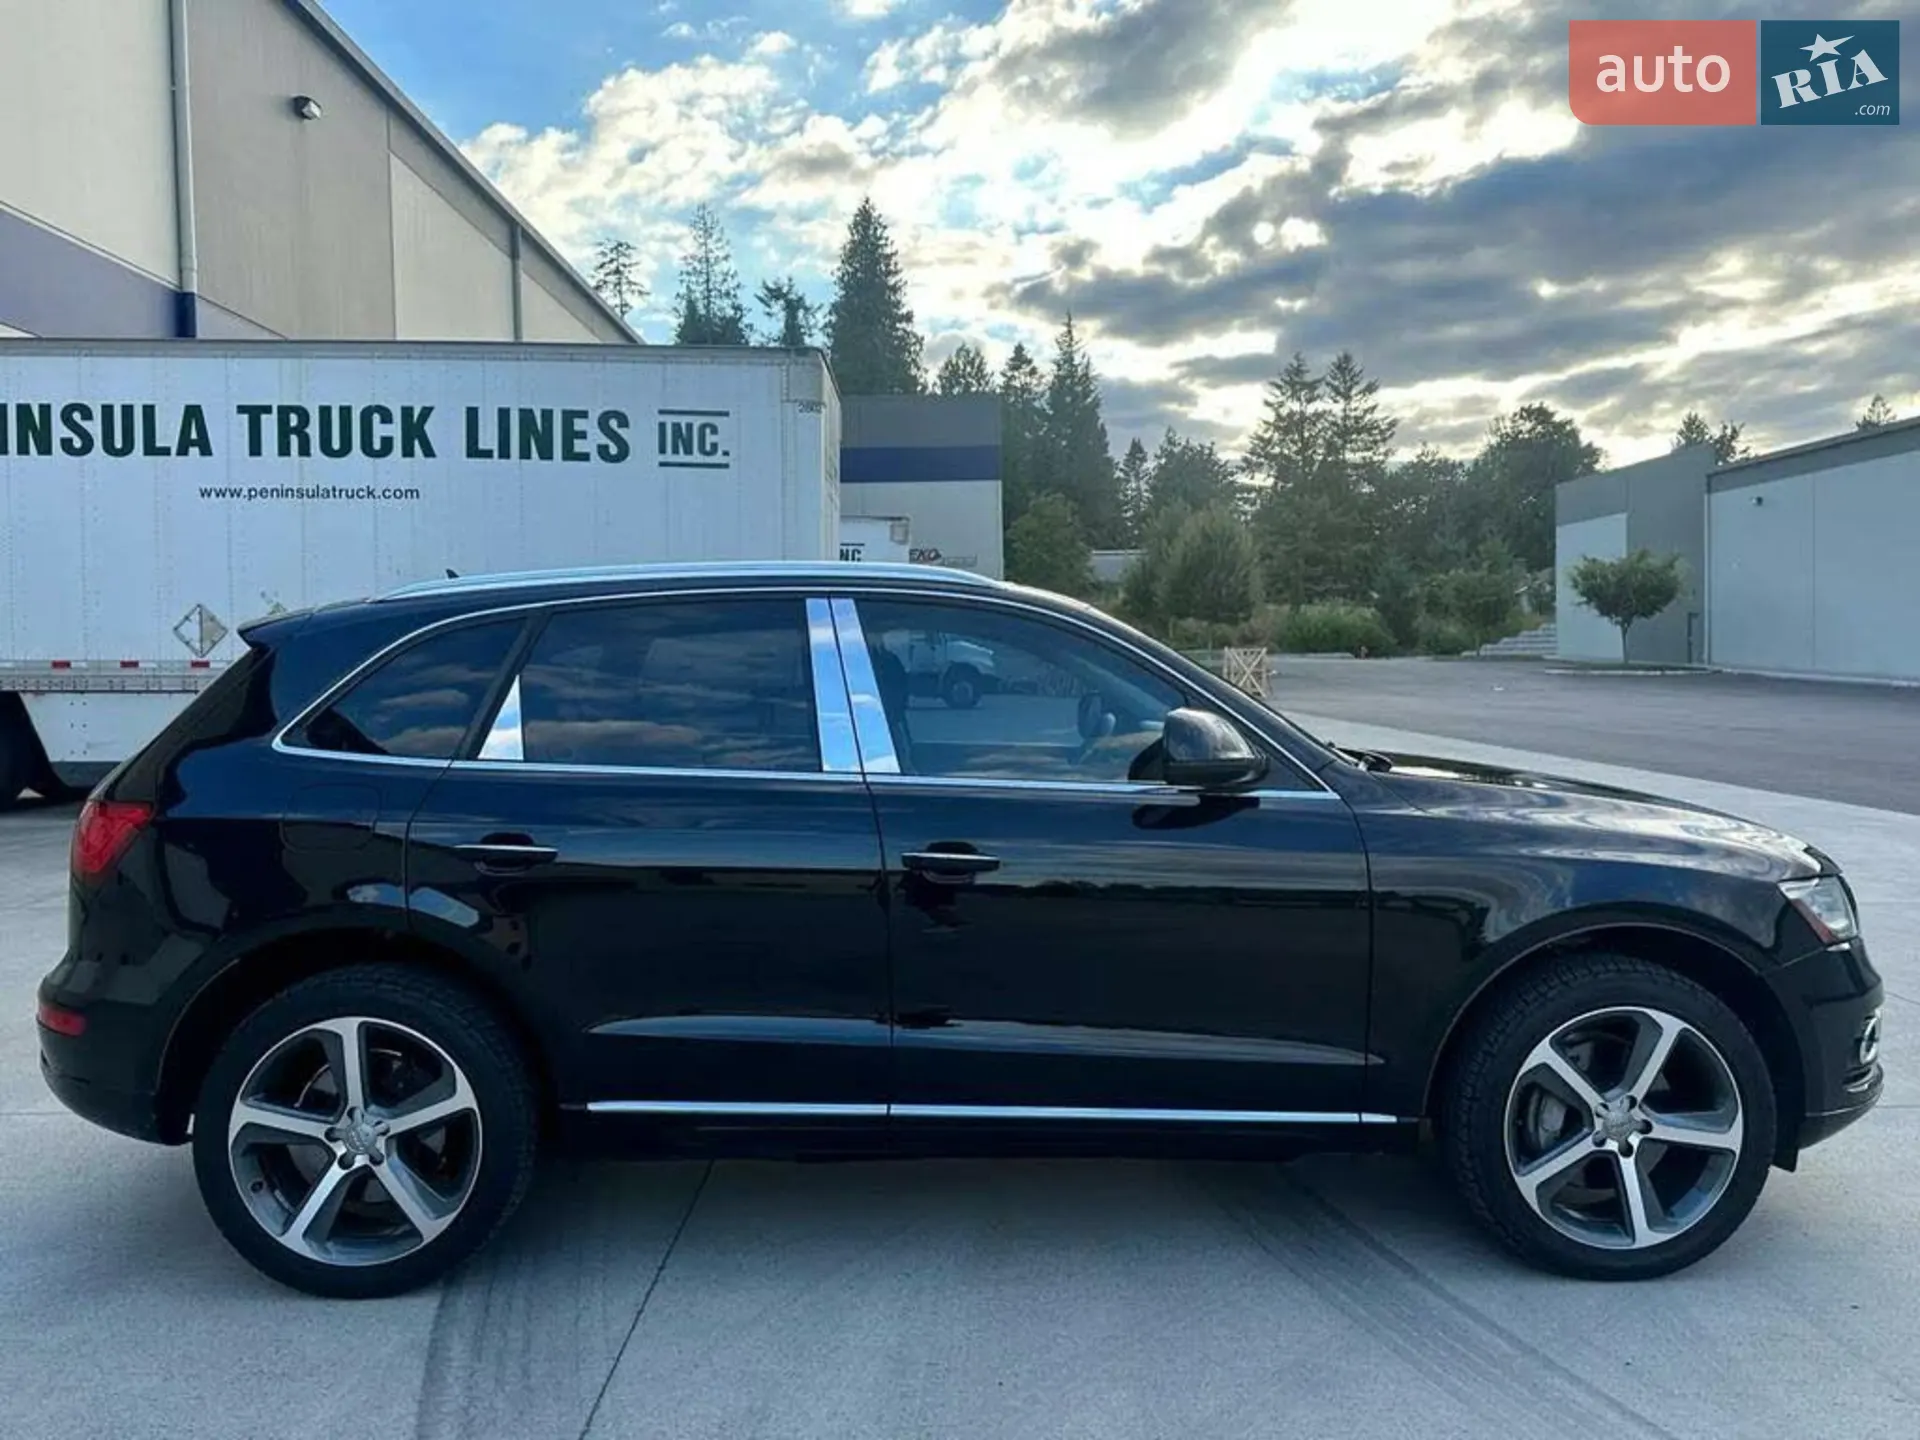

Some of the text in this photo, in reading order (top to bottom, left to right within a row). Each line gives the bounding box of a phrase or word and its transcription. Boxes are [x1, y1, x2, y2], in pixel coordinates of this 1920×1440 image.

[236, 404, 437, 458] TRUCK
[465, 406, 630, 464] LINES
[657, 421, 730, 457] INC.
[199, 484, 420, 501] www.peninsulatruck.com
